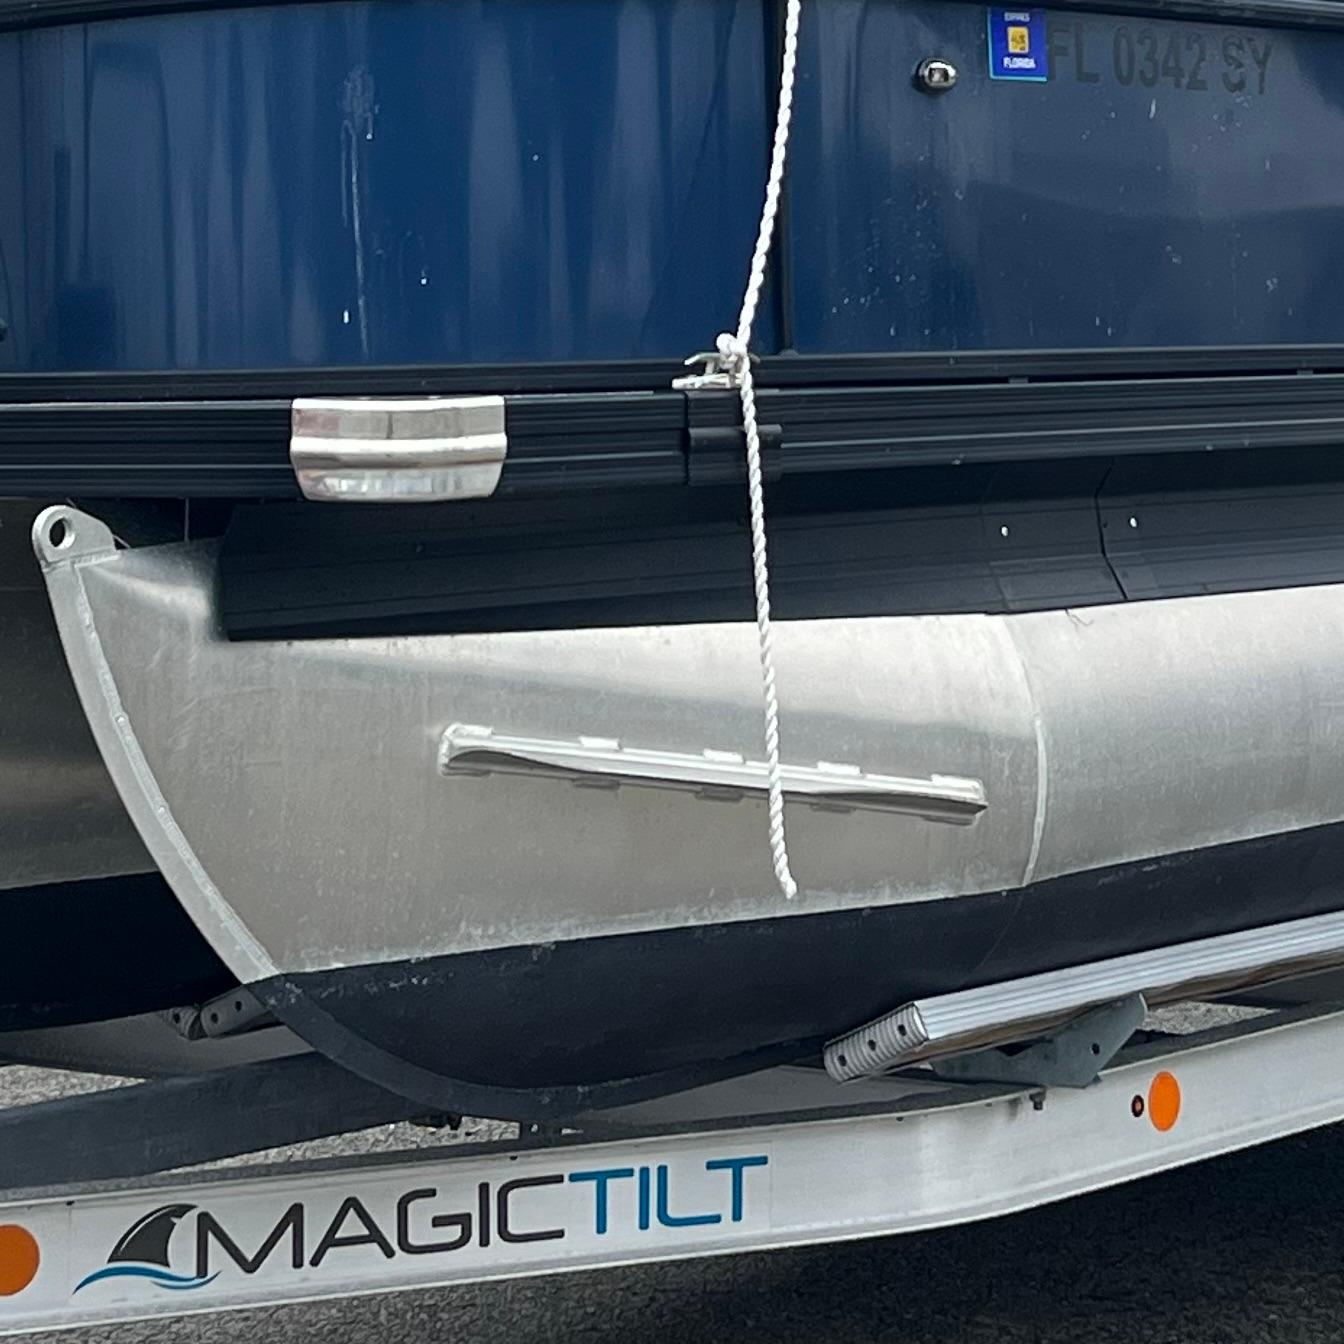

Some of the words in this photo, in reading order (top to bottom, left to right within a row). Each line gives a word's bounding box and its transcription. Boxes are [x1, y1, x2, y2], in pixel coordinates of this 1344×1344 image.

[1047, 28, 1101, 85] FL
[1112, 25, 1209, 91] 0342
[1221, 35, 1274, 96] SY
